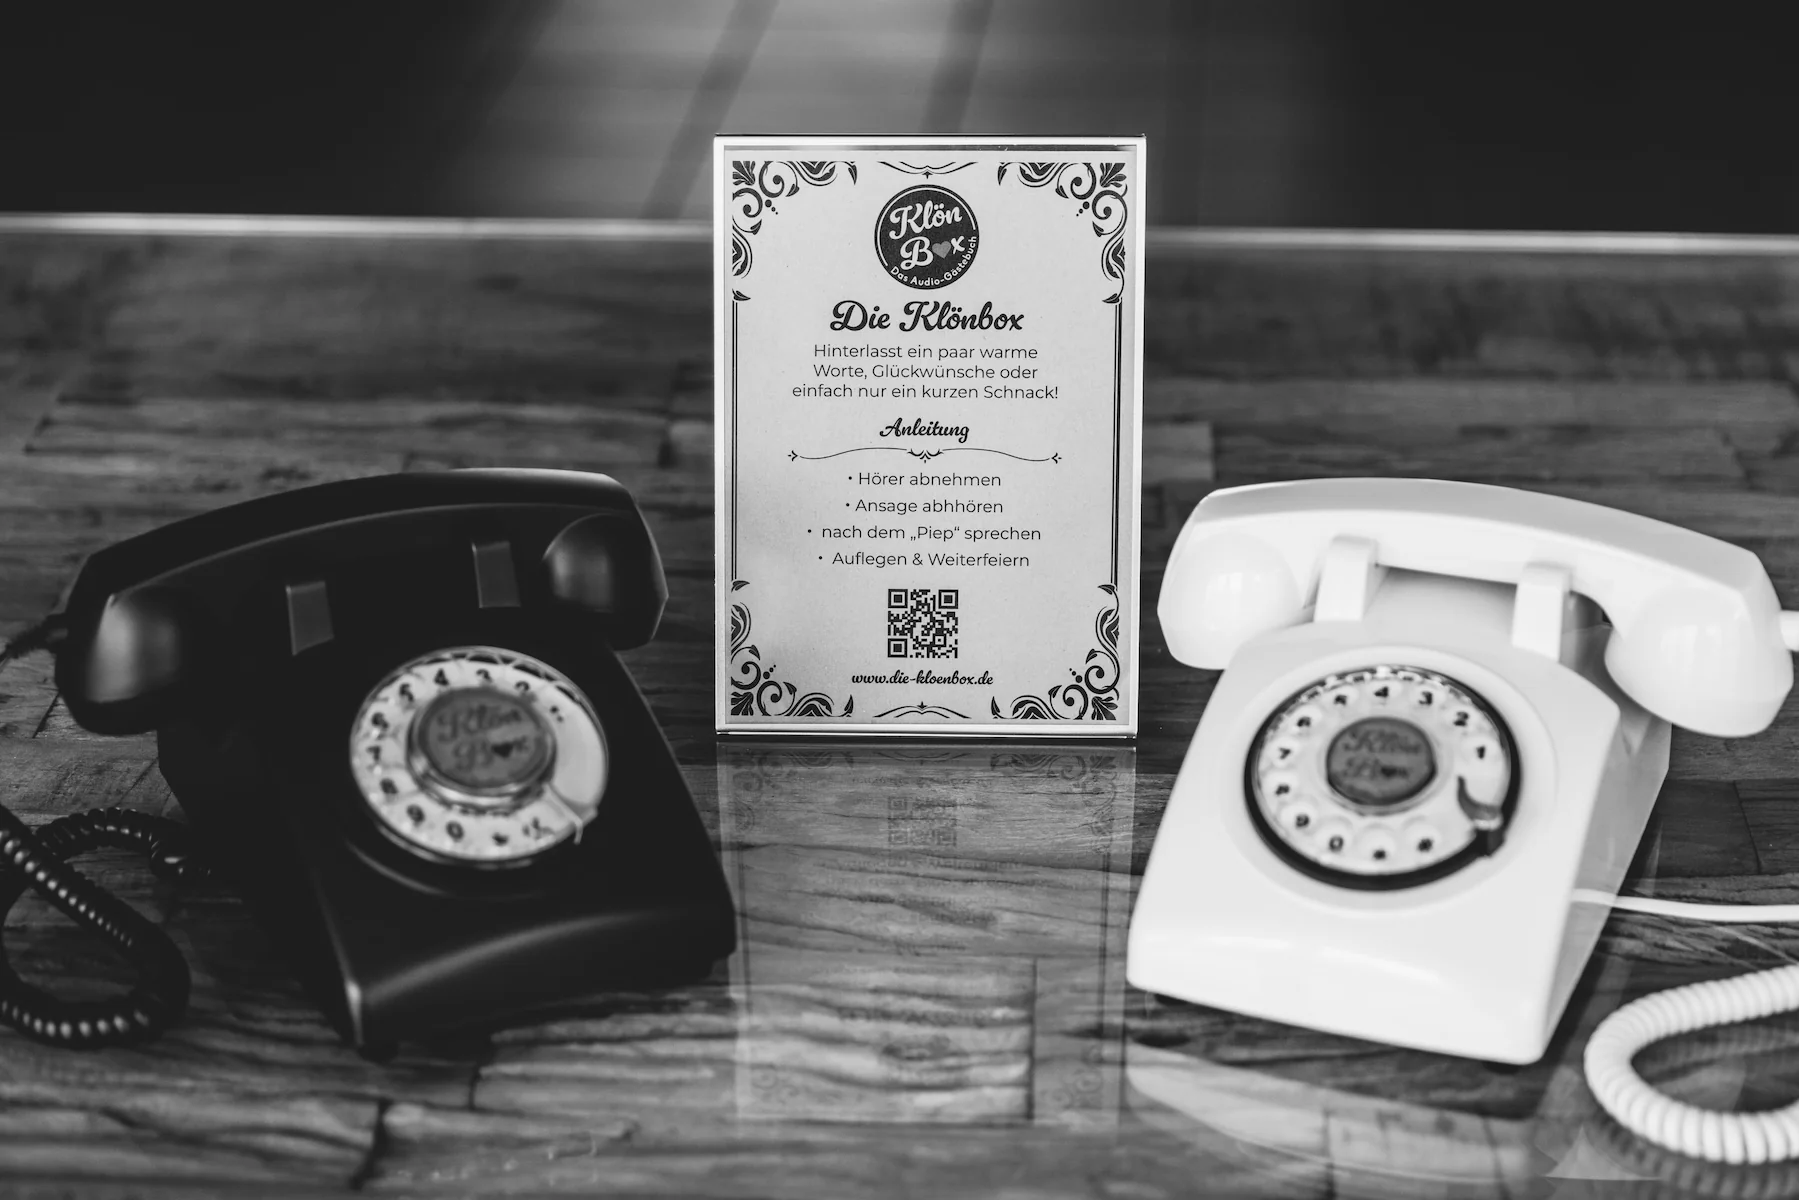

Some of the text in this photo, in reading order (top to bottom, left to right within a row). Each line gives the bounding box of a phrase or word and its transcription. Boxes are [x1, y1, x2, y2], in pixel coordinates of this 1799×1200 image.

[889, 200, 962, 239] Klön
[890, 236, 977, 286] Das Audio-Gästebuch
[830, 300, 1024, 332] Die Klönbox
[814, 344, 1038, 362] Hinterlasst ein paar warme
[814, 364, 1038, 380] Worte, Glückwünsche oder
[792, 384, 1058, 400] einfach nur ein kurzen Schnack!
[879, 417, 970, 444] Anleitung
[858, 471, 1001, 487] Hörer abnehmen
[855, 498, 1003, 515] Ansage abhhören
[822, 524, 1041, 543] nach dem „Piep“ sprechen
[832, 551, 1030, 568] Auflegen & Weiterfeiern
[851, 669, 994, 686] www.die-kloenbox.de
